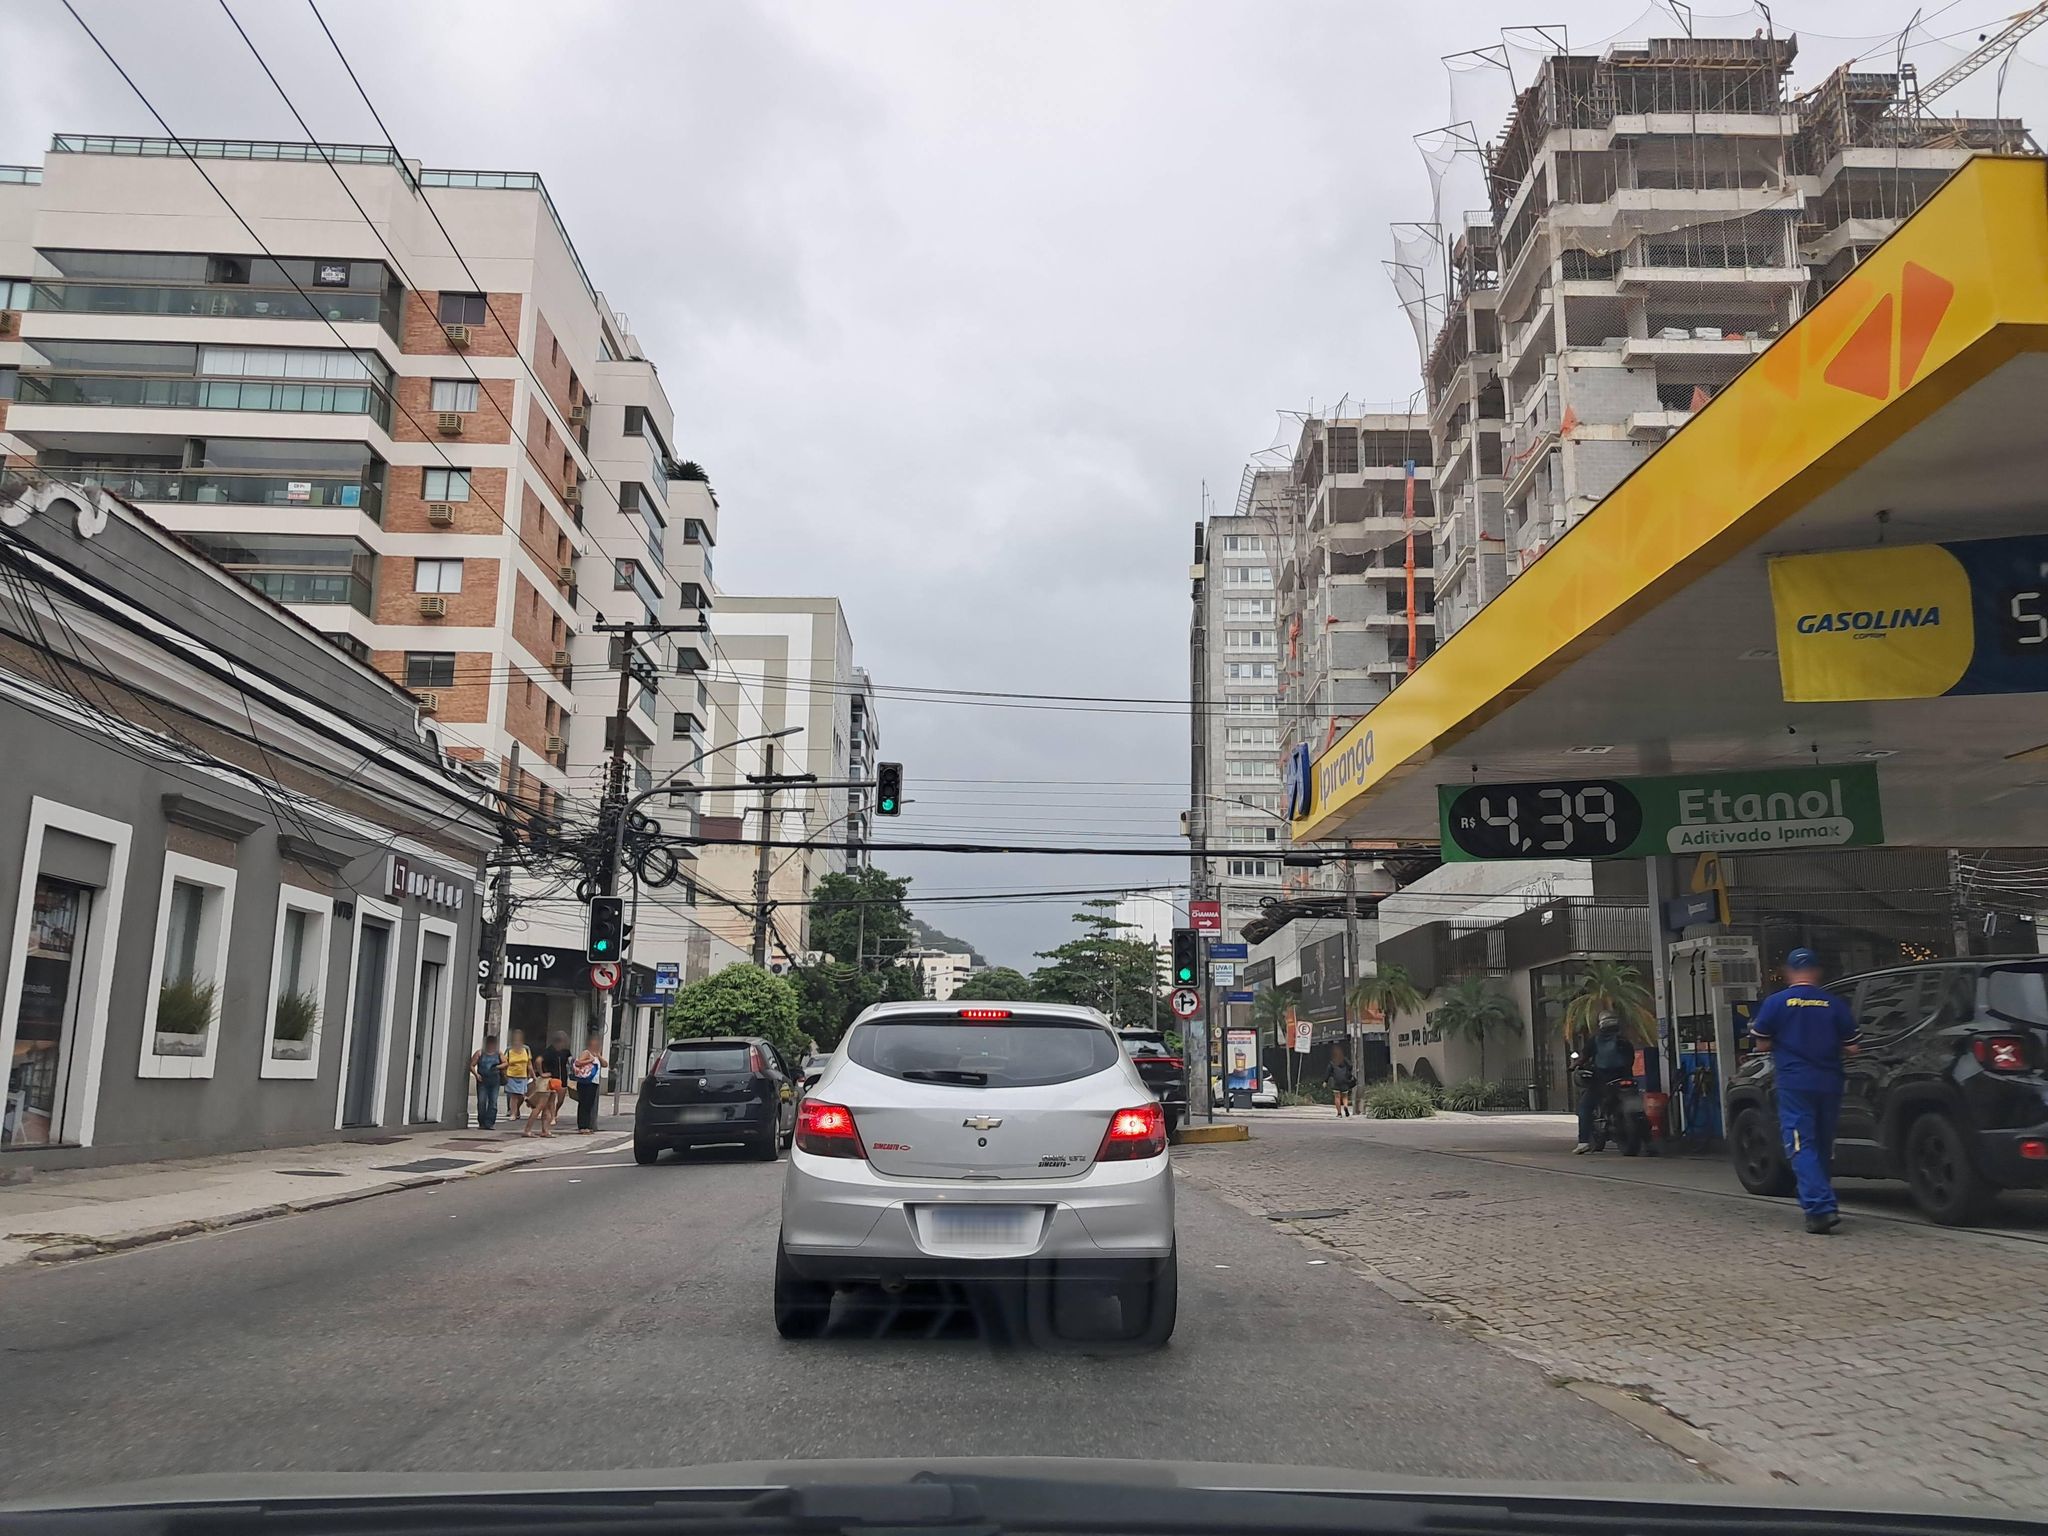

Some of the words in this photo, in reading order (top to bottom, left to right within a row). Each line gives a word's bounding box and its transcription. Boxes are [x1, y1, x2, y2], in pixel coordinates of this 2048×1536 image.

[1796, 606, 1941, 634] GASOLINA
[1319, 729, 1375, 811] Ipiranga
[1460, 816, 1476, 830] R$
[1479, 786, 1617, 852] 4,39
[1678, 778, 1843, 825] Etanol
[1680, 828, 1772, 846] Aditivado
[1778, 825, 1840, 843] Ipimax
